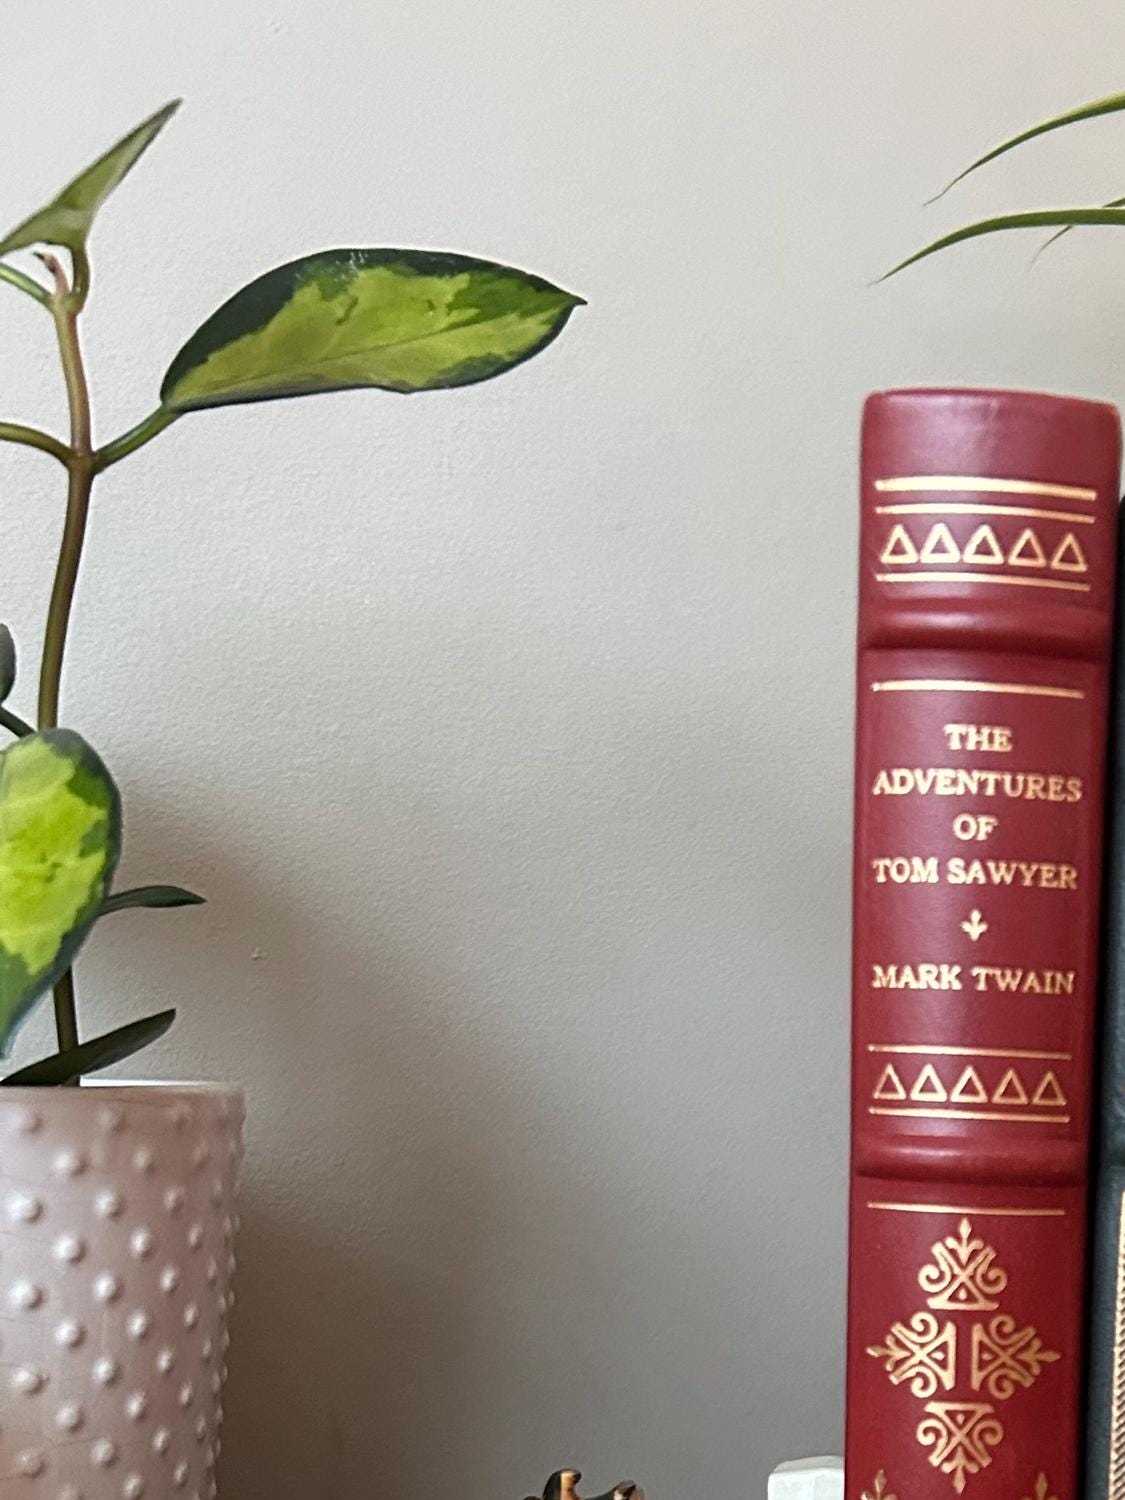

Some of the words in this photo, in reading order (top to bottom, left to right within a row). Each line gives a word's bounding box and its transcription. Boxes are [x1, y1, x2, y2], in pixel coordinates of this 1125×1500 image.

[943, 723, 1013, 753] THE
[871, 767, 1083, 802] ADVENTURES
[951, 813, 998, 841] OF
[871, 856, 939, 884] TOM
[946, 857, 1078, 890] SAWYER
[871, 963, 963, 991] MARK
[970, 965, 1076, 995] TWAIN
